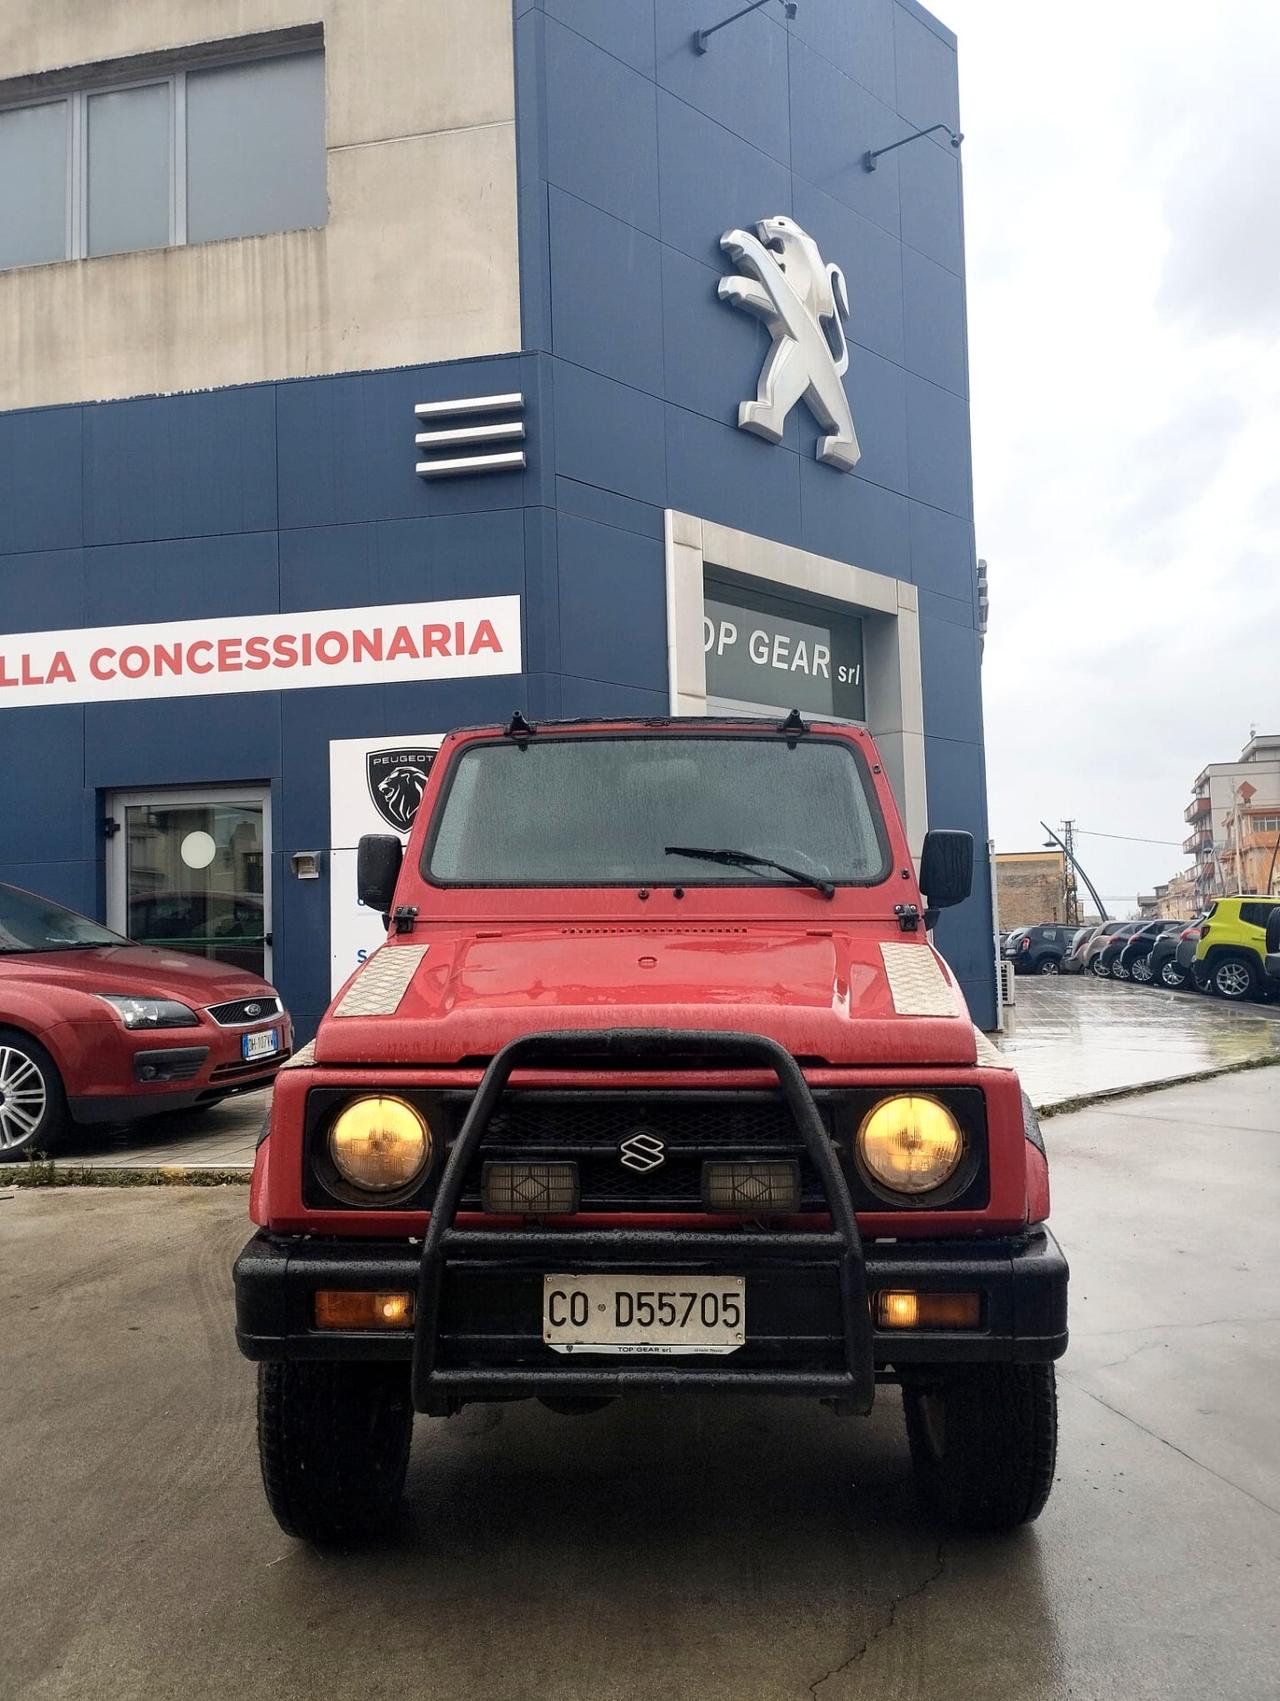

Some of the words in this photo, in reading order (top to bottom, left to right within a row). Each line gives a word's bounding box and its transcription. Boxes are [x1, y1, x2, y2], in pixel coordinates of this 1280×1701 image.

[0, 651, 77, 688] LLA
[89, 619, 504, 681] CONCESSIONARIA
[749, 630, 831, 679] GEAR
[837, 664, 860, 685] srl
[373, 755, 434, 765] PEUGEOT
[549, 1291, 589, 1327] CO
[615, 1291, 741, 1328] D55705
